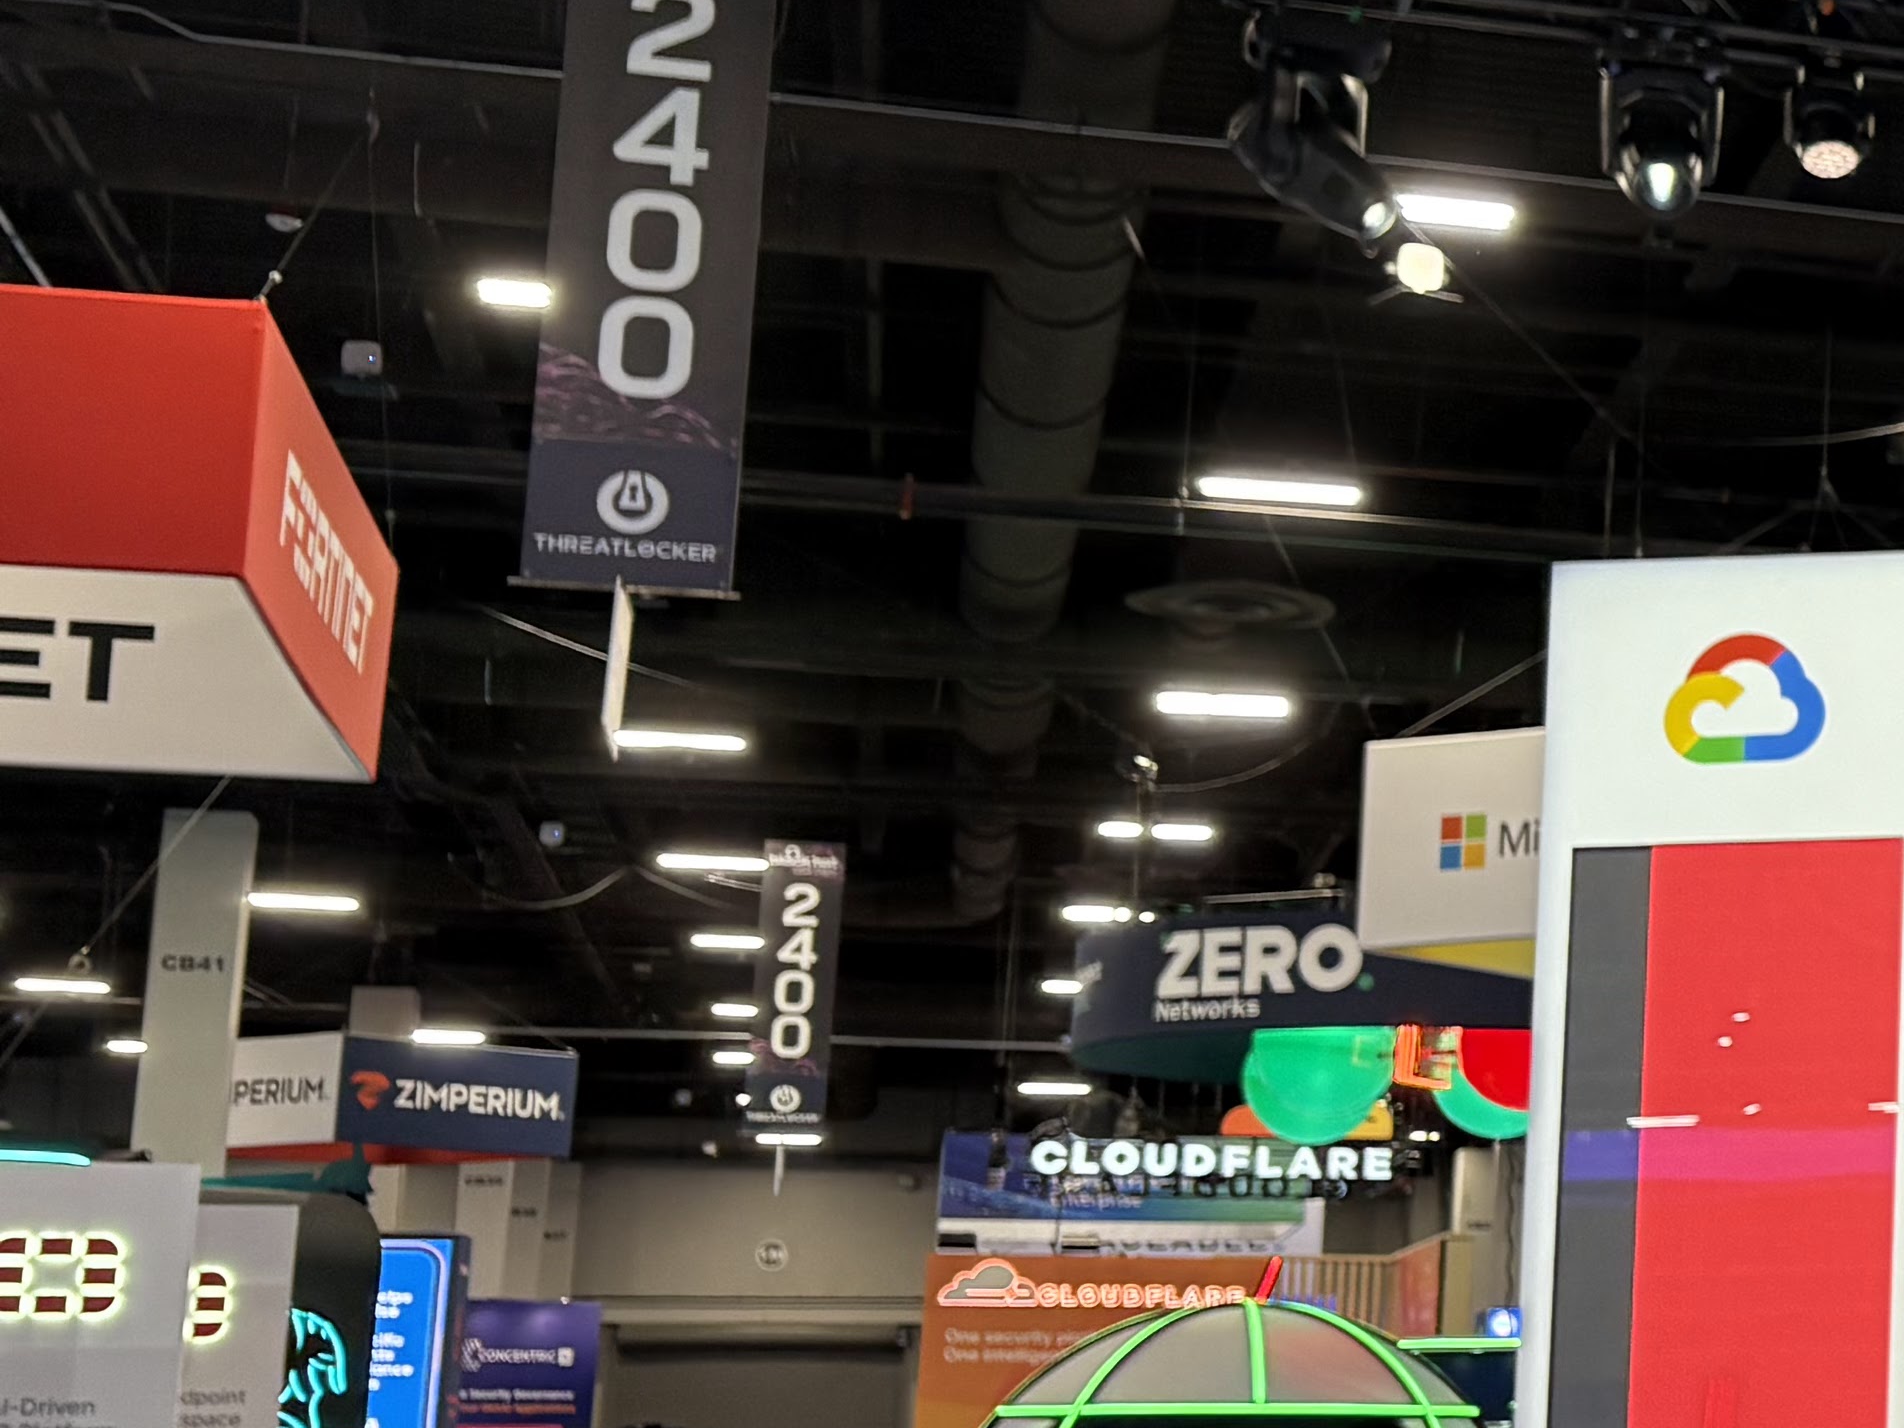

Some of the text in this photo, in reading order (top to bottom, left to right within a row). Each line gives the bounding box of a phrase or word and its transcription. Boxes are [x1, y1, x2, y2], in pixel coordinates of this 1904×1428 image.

[279, 447, 374, 676] FORTINET
[533, 531, 717, 563] THREATLOCKER
[1498, 819, 1540, 858] Mi
[770, 882, 821, 1060] 2400
[1156, 922, 1364, 999] ZERO
[1153, 996, 1261, 1023] Networks
[233, 1076, 325, 1108] PERIUM
[394, 1078, 562, 1121] ZIMPERIUM
[1031, 1140, 1394, 1181] CLOUDFLARE
[1037, 1282, 1246, 1308] CLOUDFLARE
